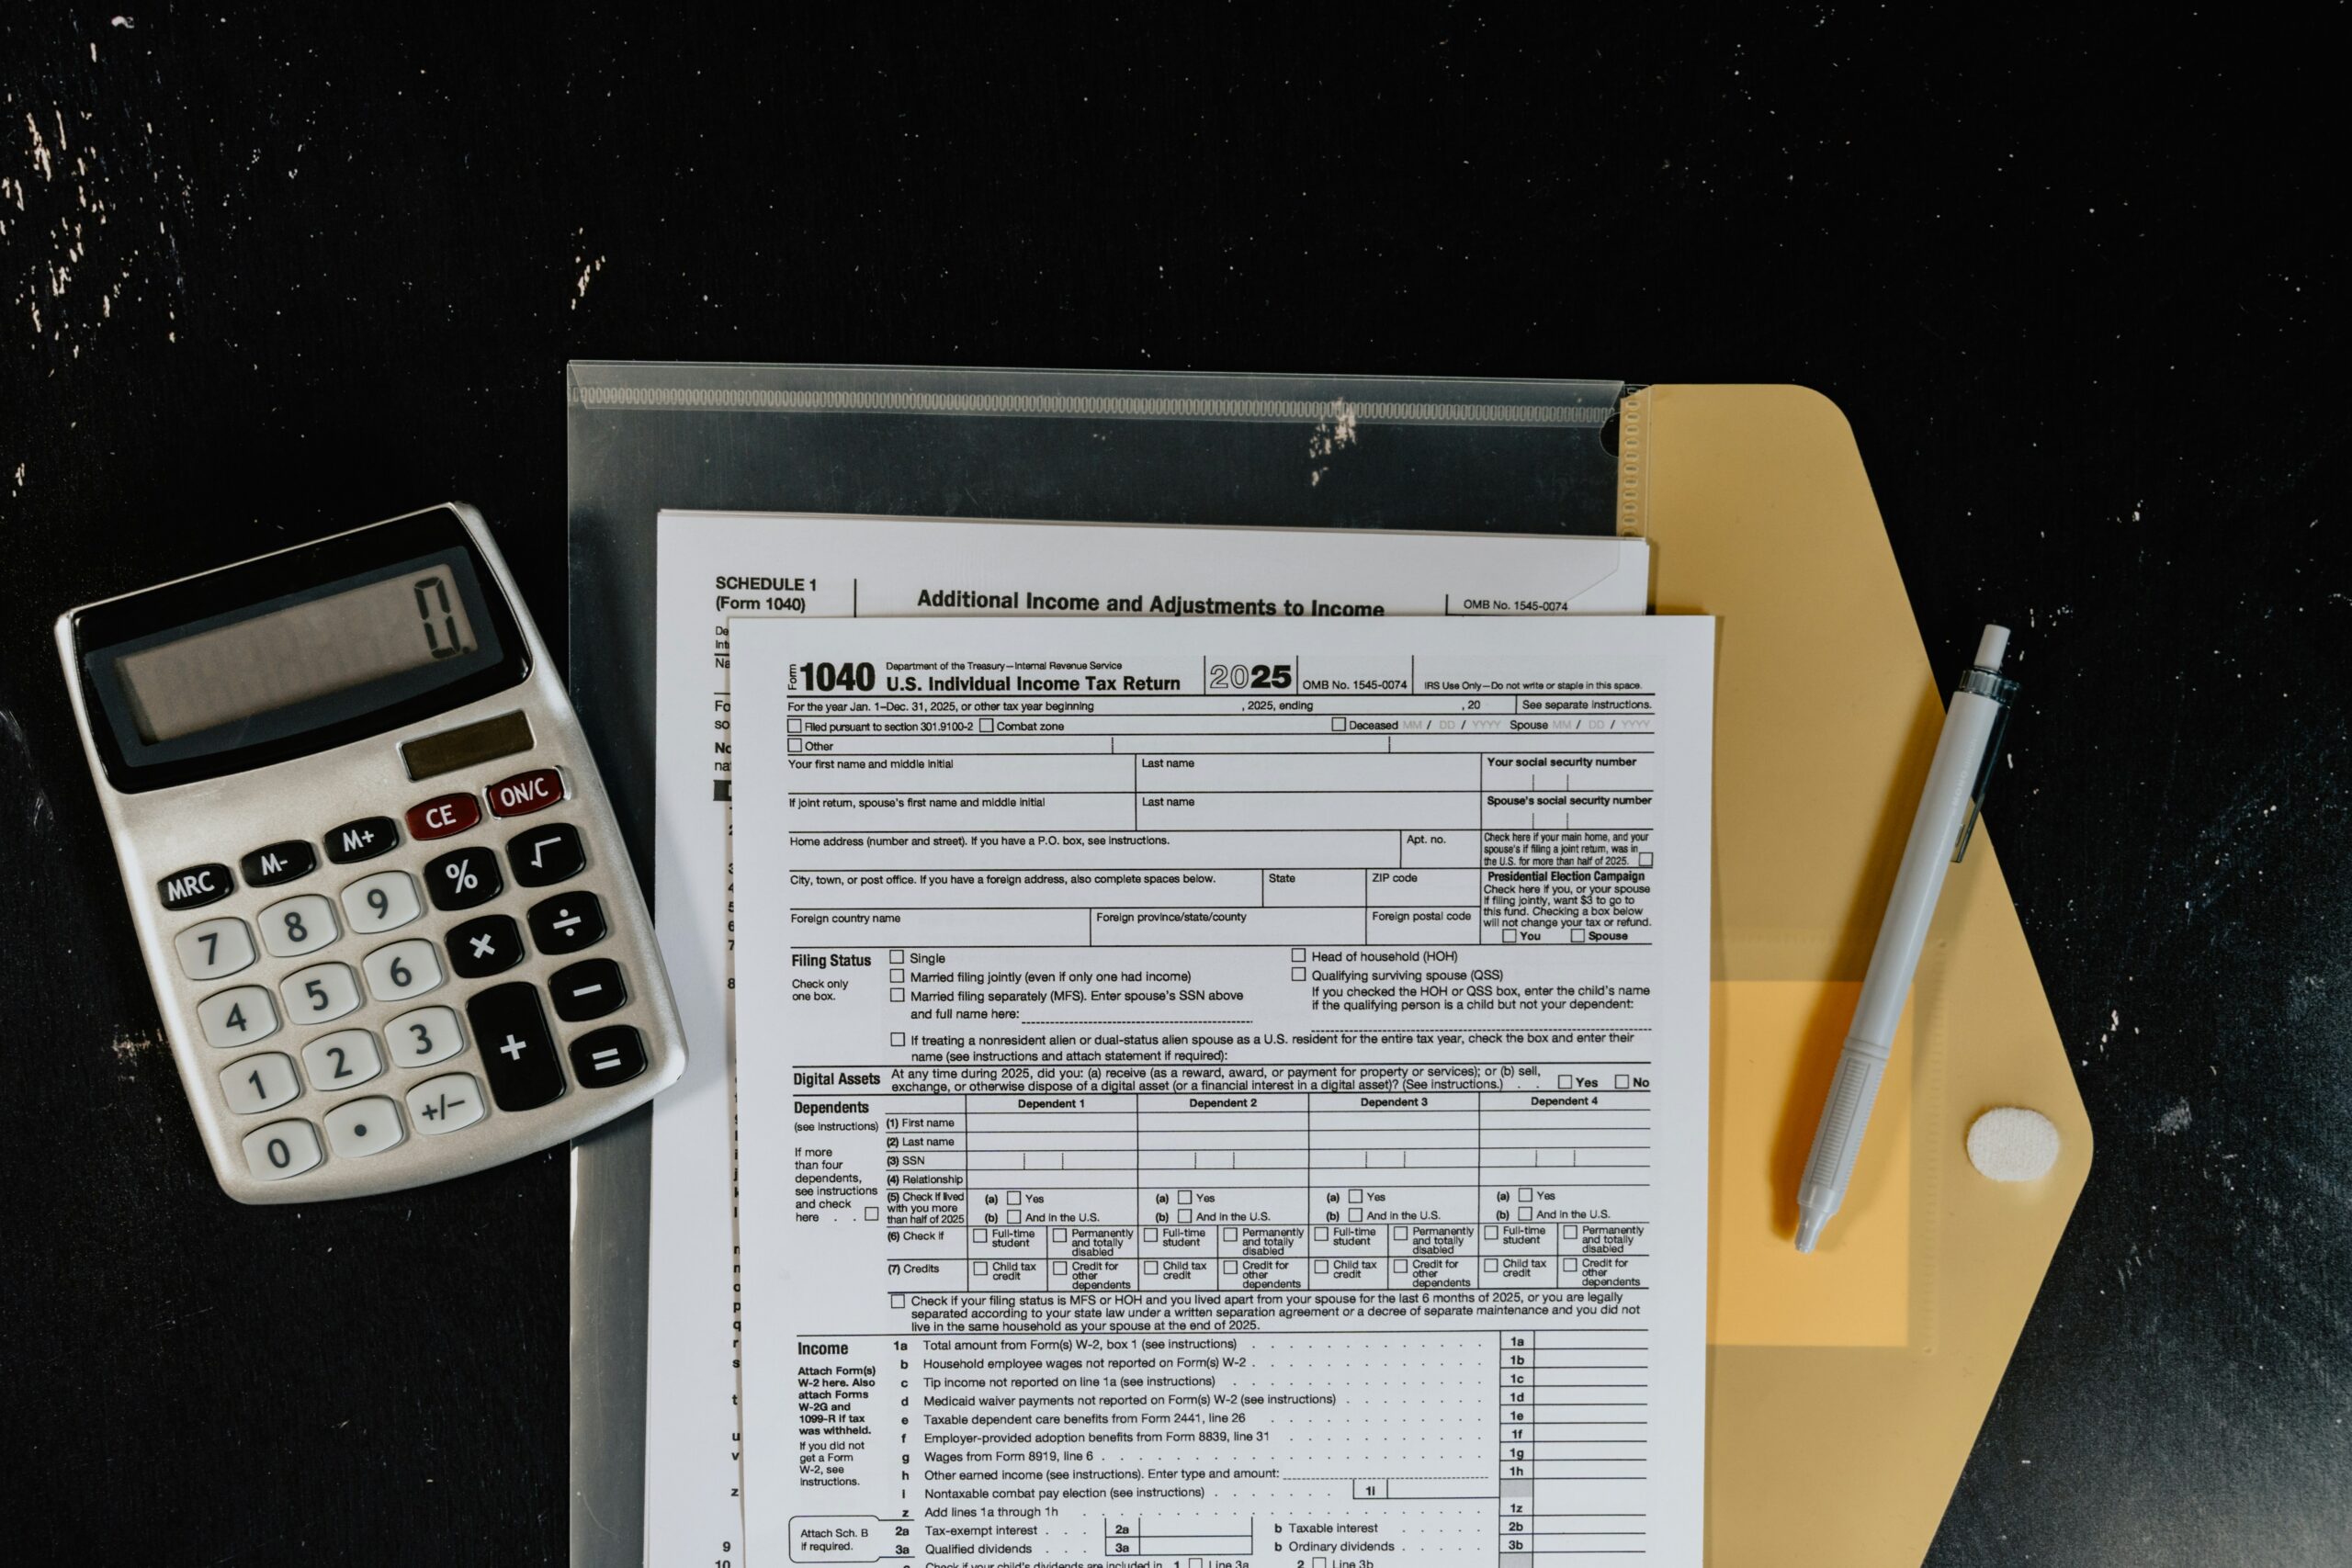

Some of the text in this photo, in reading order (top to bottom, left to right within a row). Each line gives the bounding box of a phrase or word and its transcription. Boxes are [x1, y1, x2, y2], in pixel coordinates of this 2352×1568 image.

[715, 575, 817, 592] SCHEDULE 1
[716, 595, 807, 615] (Form 1040)
[917, 589, 1385, 616] Additional Income and Adjustments to Income
[1463, 598, 1568, 612] OMB No. 1545-0074
[886, 661, 938, 672] Department
[939, 661, 949, 671] of
[950, 661, 966, 671] the
[1048, 660, 1088, 671] Revenue
[1089, 660, 1123, 671] Service
[787, 663, 797, 691] Form
[799, 661, 876, 692] 1040
[1209, 664, 1293, 690] 2025
[886, 675, 1181, 692] U.S. Individual Income Tax Return
[1302, 679, 1408, 691] OMB No. 1545-0074
[1424, 681, 1441, 691] IRS
[1442, 681, 1461, 691] Use
[1505, 682, 1521, 691] not
[1521, 682, 1544, 690] write
[1556, 681, 1585, 692] staple
[1585, 681, 1594, 690] in
[1595, 681, 1612, 690] this
[1613, 682, 1641, 692] space.
[1521, 699, 1653, 712] See separate instructions.
[996, 720, 1065, 732] Combat zone
[1349, 720, 1399, 730] Deceased
[1510, 720, 1549, 733] Spouse
[787, 759, 954, 770] Your first name and middle initial
[1487, 756, 1638, 769] Your social security number
[500, 778, 549, 808] ON/C
[425, 804, 457, 829] CE
[343, 829, 375, 852] M+
[1406, 834, 1446, 846] Apt. no.
[260, 853, 289, 876] M-
[446, 860, 478, 894] %
[1268, 873, 1296, 884] State
[1372, 873, 1419, 883] ZIP code
[1487, 870, 1645, 884] Presidential Election Campaign
[167, 871, 215, 901] MRC
[368, 889, 390, 919] 9
[790, 913, 901, 926] Foreign country name
[285, 911, 308, 942] 8
[1519, 931, 1542, 942] You
[1588, 931, 1629, 942] Spouse
[198, 931, 219, 965] 7
[791, 953, 872, 970] Filing Status
[910, 953, 946, 966] Single
[1311, 950, 1458, 964] Head of household (HOH)
[390, 956, 413, 987] 6
[1311, 969, 1504, 984] Qualifying surviving spouse (QSS)
[305, 979, 328, 1010] 5
[226, 1003, 247, 1032] 4
[409, 1024, 433, 1055] 3
[326, 1048, 353, 1078] 2
[248, 1070, 267, 1099] 1
[793, 1072, 881, 1089] Digital Assets
[1575, 1077, 1599, 1089] Yes
[1633, 1077, 1650, 1089] No
[794, 1100, 870, 1117] Dependents
[1017, 1099, 1085, 1111] Dependent 1
[1189, 1098, 1258, 1111] Dependent 2
[1360, 1097, 1429, 1110] Dependent 3
[1531, 1096, 1599, 1108] Dependent 4
[886, 1117, 956, 1130] (1) First name
[267, 1138, 290, 1168] 0
[887, 1155, 925, 1168] (3) SSN
[797, 1341, 849, 1356] Income
[1510, 1336, 1525, 1348] 1a
[731, 1359, 741, 1370] s
[797, 1365, 876, 1378] Attach Form(s)
[797, 1377, 876, 1388] W-2 here. Also
[731, 1393, 741, 1408] t
[731, 1431, 742, 1442] u
[730, 1450, 741, 1462] v
[923, 1450, 1094, 1465] Wages from Form 8919, line 6
[730, 1487, 740, 1497] z
[1510, 1503, 1523, 1514] 1z
[924, 1525, 1038, 1539] Tax-exempt interest
[1288, 1522, 1379, 1534] Taxable interest
[1508, 1521, 1524, 1532] 2b
[722, 1540, 731, 1553] 9
[924, 1543, 1033, 1555] Qualified dividends
[1288, 1540, 1396, 1554] Ordinary dividends
[1508, 1540, 1524, 1551] 3b
